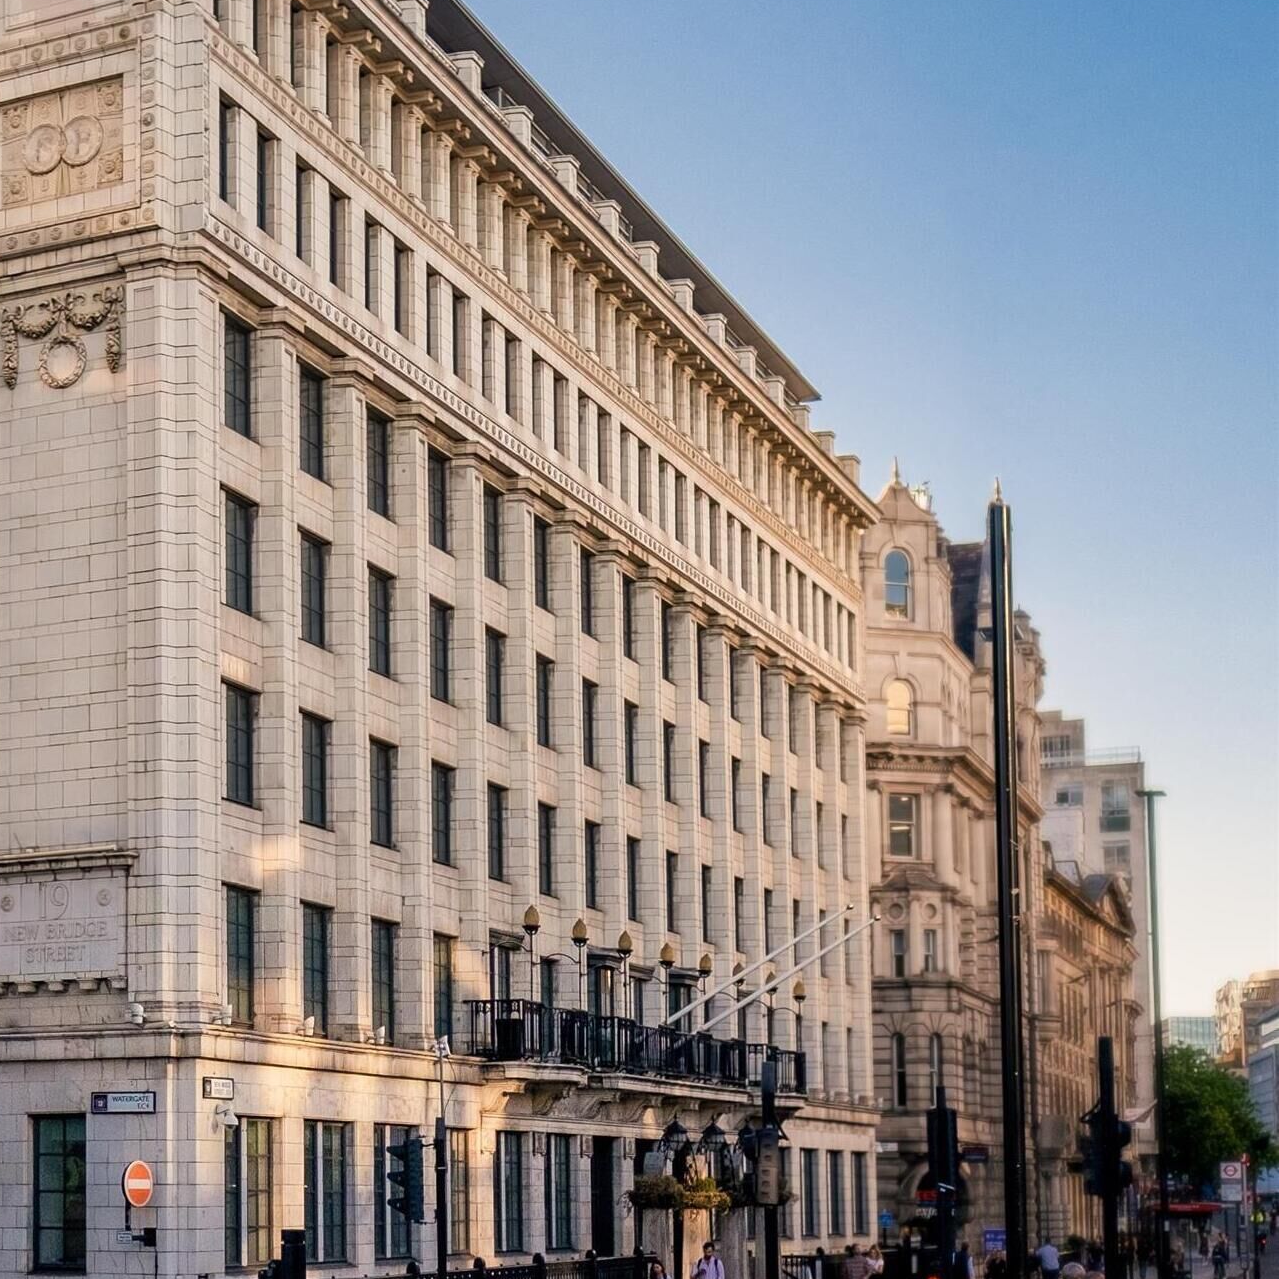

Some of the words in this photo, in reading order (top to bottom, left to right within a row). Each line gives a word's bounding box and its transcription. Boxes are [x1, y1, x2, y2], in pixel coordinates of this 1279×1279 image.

[38, 882, 70, 921] 19
[3, 925, 40, 942] NEW
[44, 921, 108, 940] BRIDGE
[25, 945, 87, 963] STREET
